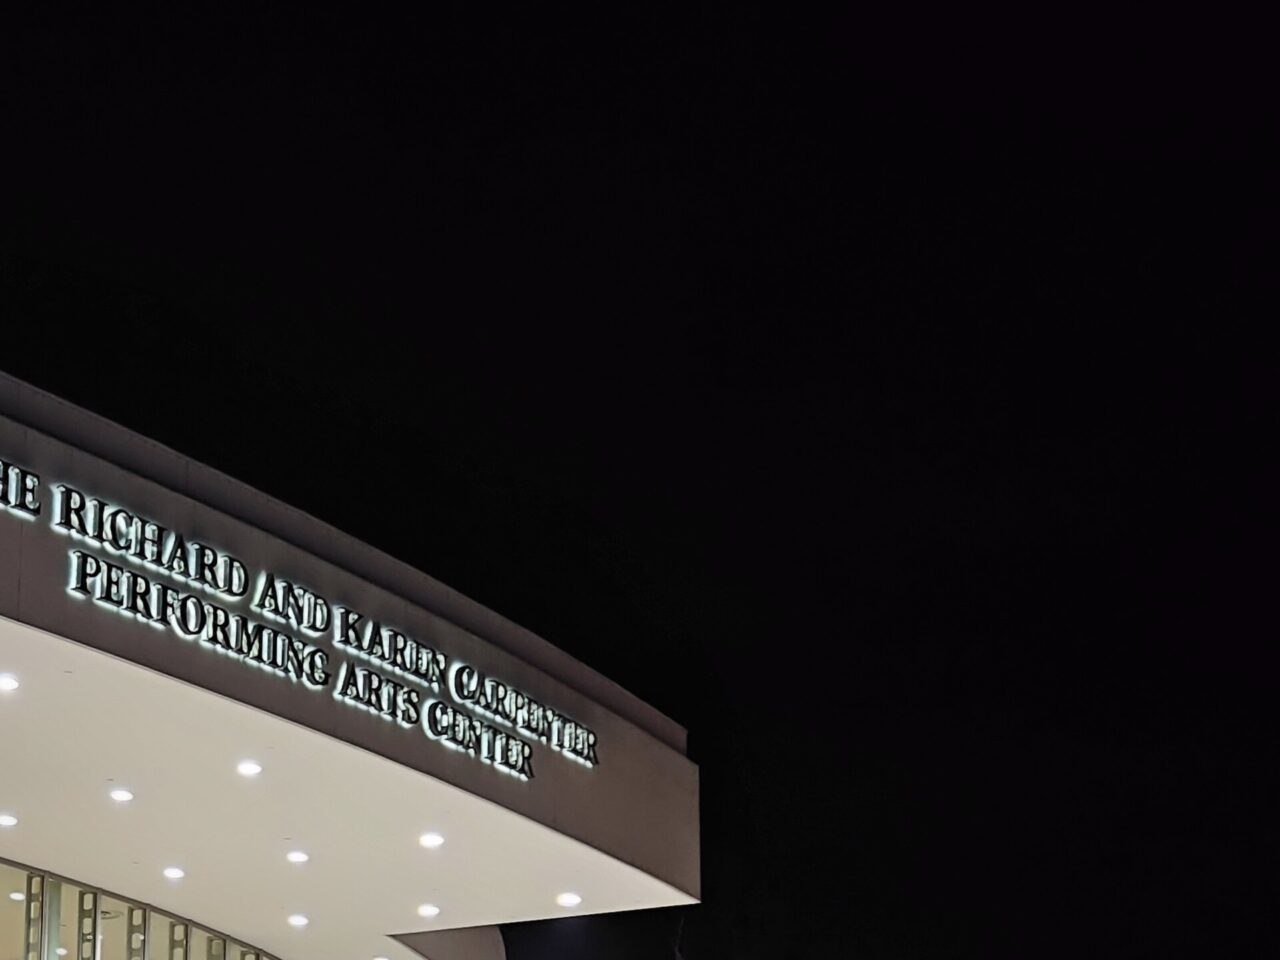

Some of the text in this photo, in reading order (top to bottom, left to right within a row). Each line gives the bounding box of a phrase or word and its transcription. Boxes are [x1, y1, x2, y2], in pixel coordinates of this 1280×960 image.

[50, 483, 249, 600] RICHARD
[251, 568, 331, 636] AND
[334, 606, 448, 692] KAREN
[449, 662, 599, 768] CARPENTER
[67, 550, 535, 781] PERFORMING ARTS CENTER
